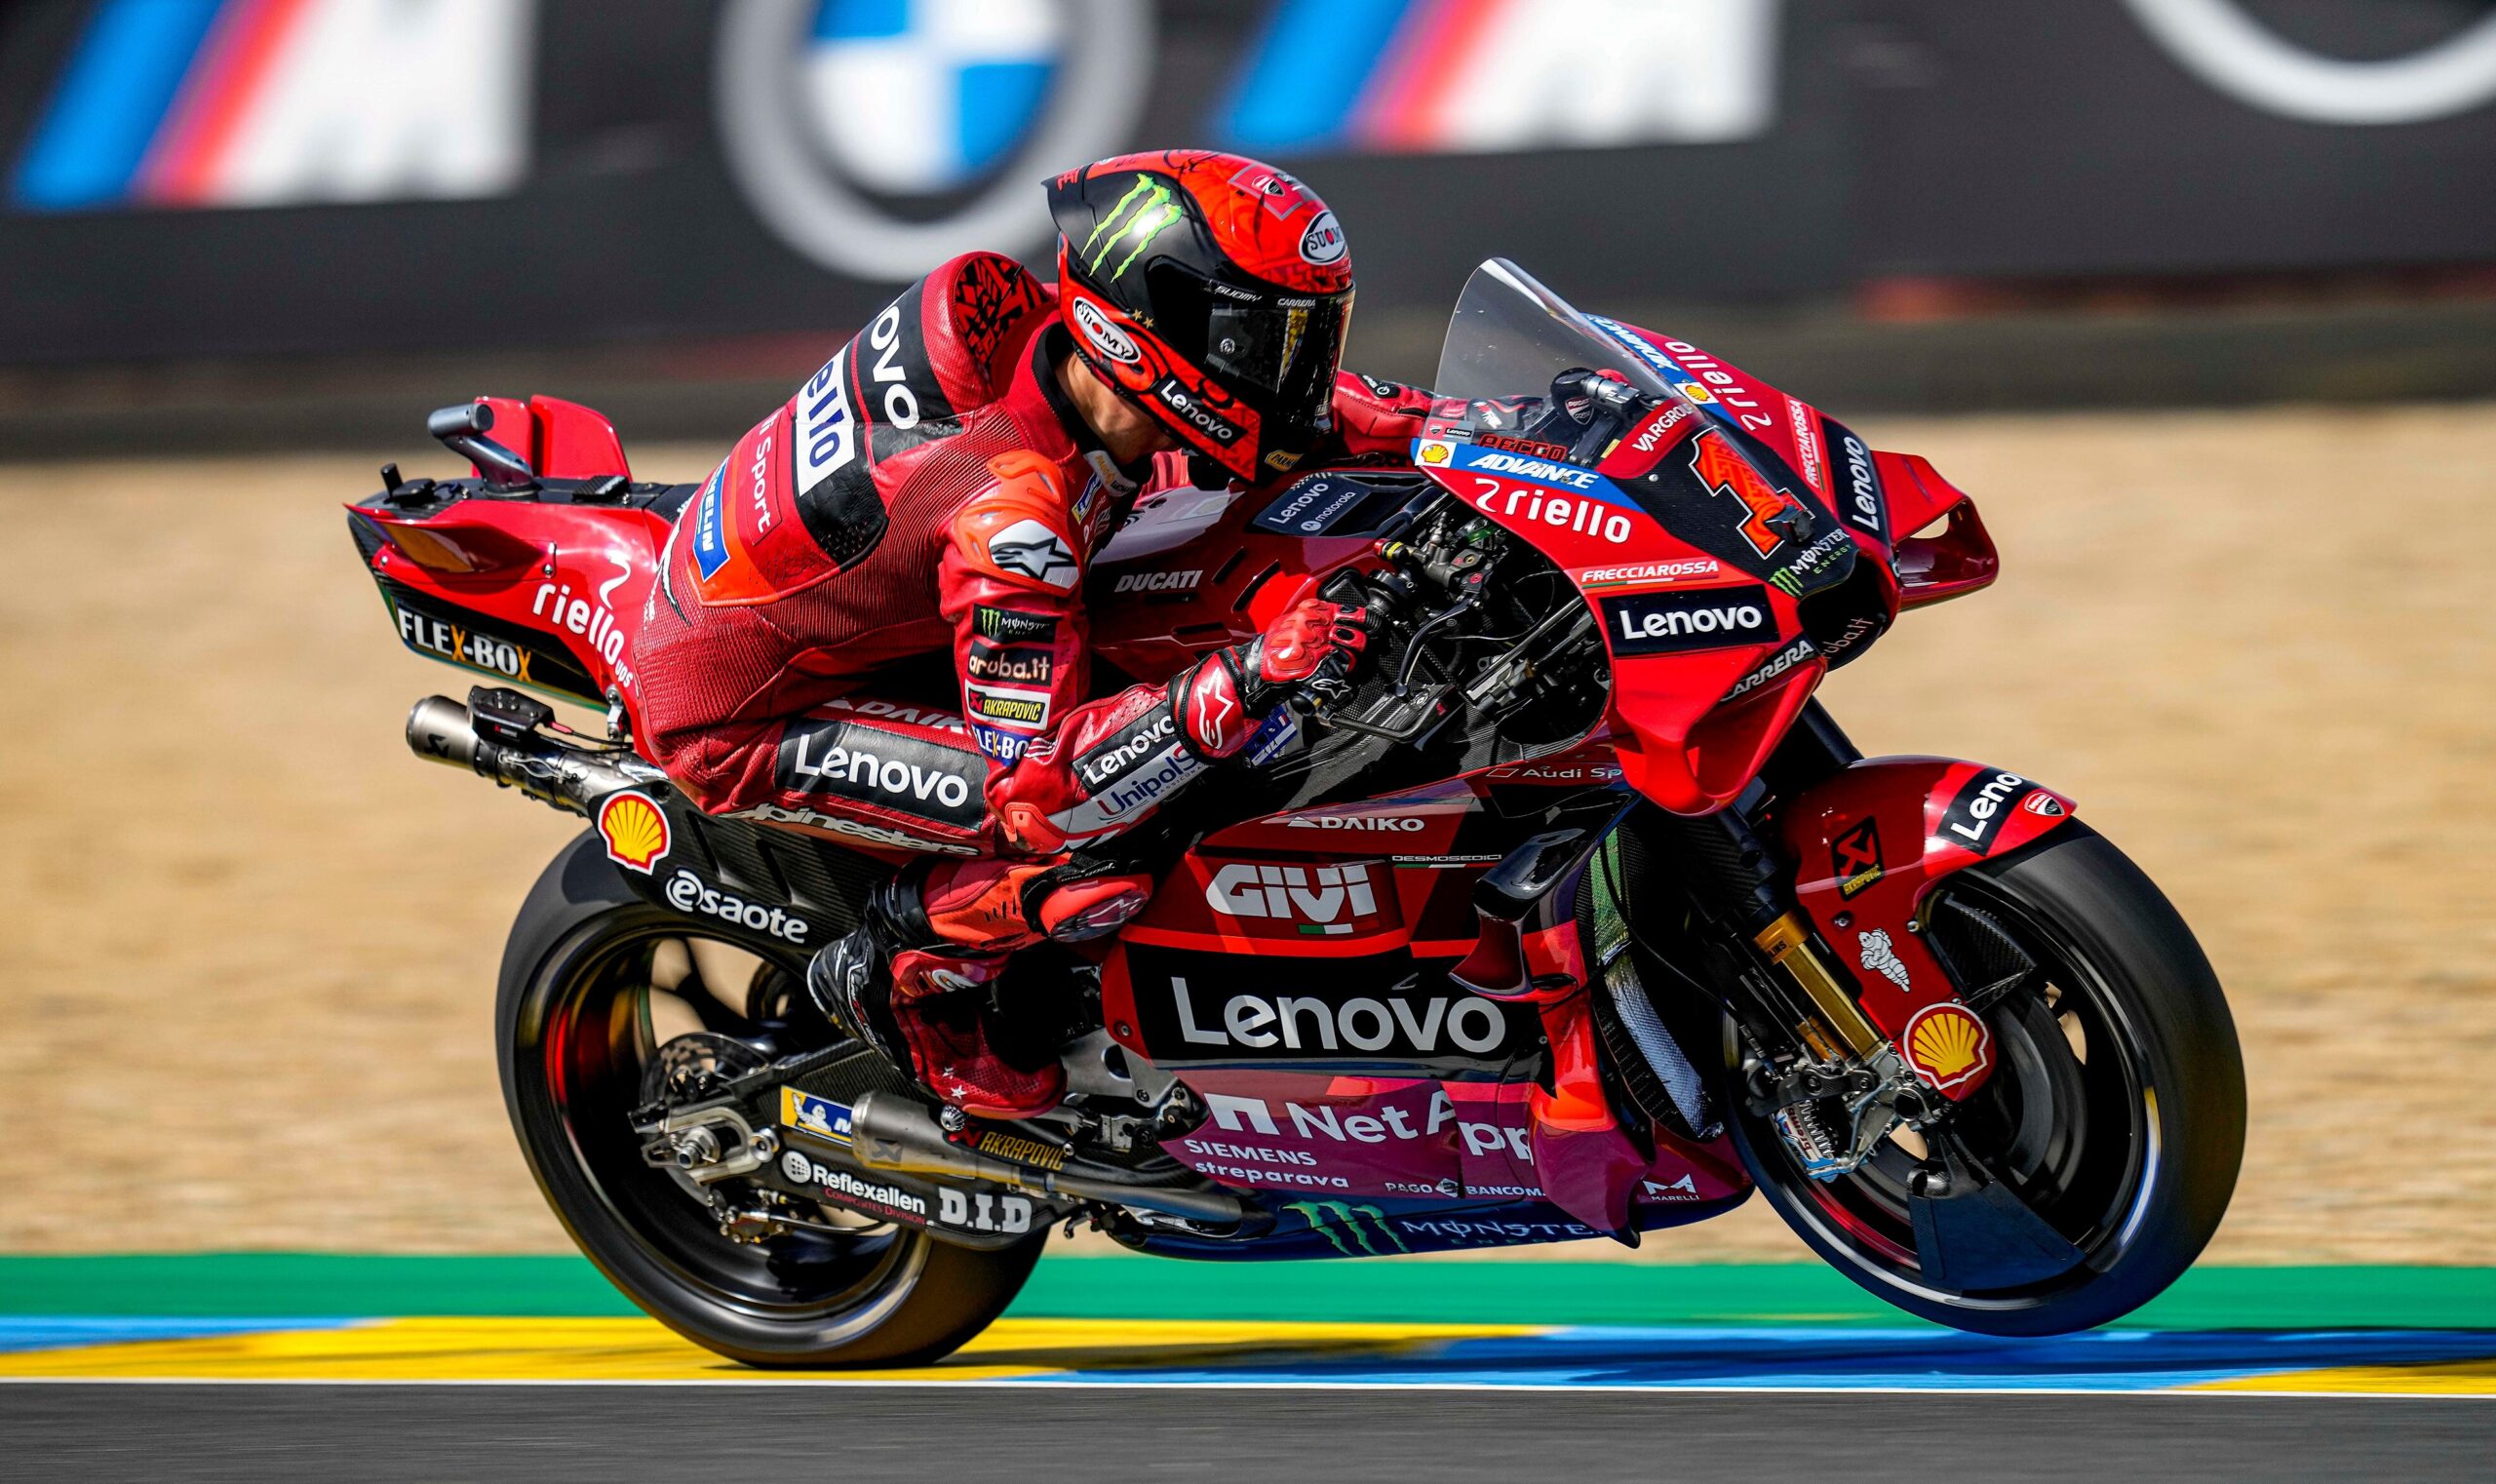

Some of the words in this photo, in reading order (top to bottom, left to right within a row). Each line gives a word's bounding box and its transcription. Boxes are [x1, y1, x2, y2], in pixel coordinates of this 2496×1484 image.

[1306, 225, 1344, 252] SUOM
[1277, 297, 1316, 307] CARRERA
[1075, 301, 1133, 360] SUOMY
[871, 305, 919, 430] ovo
[1664, 340, 1758, 409] riello
[806, 360, 845, 468] ello
[1161, 379, 1233, 440] Lenovo
[1631, 402, 1694, 452] VARGROU
[1477, 434, 1569, 463] PECCO
[1788, 399, 1819, 488] FRECCIAROSSA
[751, 436, 771, 533] Sport
[1467, 453, 1599, 488] ADVANCE
[1843, 436, 1881, 531] Lenovo
[1268, 483, 1330, 524] Lenovo
[1314, 491, 1357, 522] motorola
[1504, 489, 1632, 543] riello
[1114, 569, 1204, 593] DUCATI
[1580, 561, 1720, 583] FRECCIAROSSA
[397, 606, 532, 682] FLEX-BOX
[532, 584, 625, 666] riello
[1618, 605, 1763, 640] Lenovo
[968, 651, 1051, 682] aruba.it
[855, 700, 971, 735] DAIK
[795, 733, 968, 808] Lenovo
[1097, 745, 1196, 816] UnipolS
[1522, 767, 1581, 778] Audi
[717, 801, 980, 857] alpinestars
[1321, 817, 1424, 832] DAIKO
[1951, 773, 2023, 841] Leno
[665, 868, 809, 946] esaote
[1205, 860, 1378, 923] GIVI
[1170, 976, 1506, 1054] Lenovo
[1184, 1139, 1317, 1167] SIEMENS
[1195, 1161, 1350, 1189] streparava
[812, 1164, 925, 1215] Reflexallen
[938, 1187, 1033, 1234] D.I.D
[1384, 1181, 1433, 1194] PAGO
[1464, 1185, 1546, 1196] BANCOM
[884, 1205, 926, 1226] DIVISION
[1400, 1219, 1603, 1238] MONSTE
